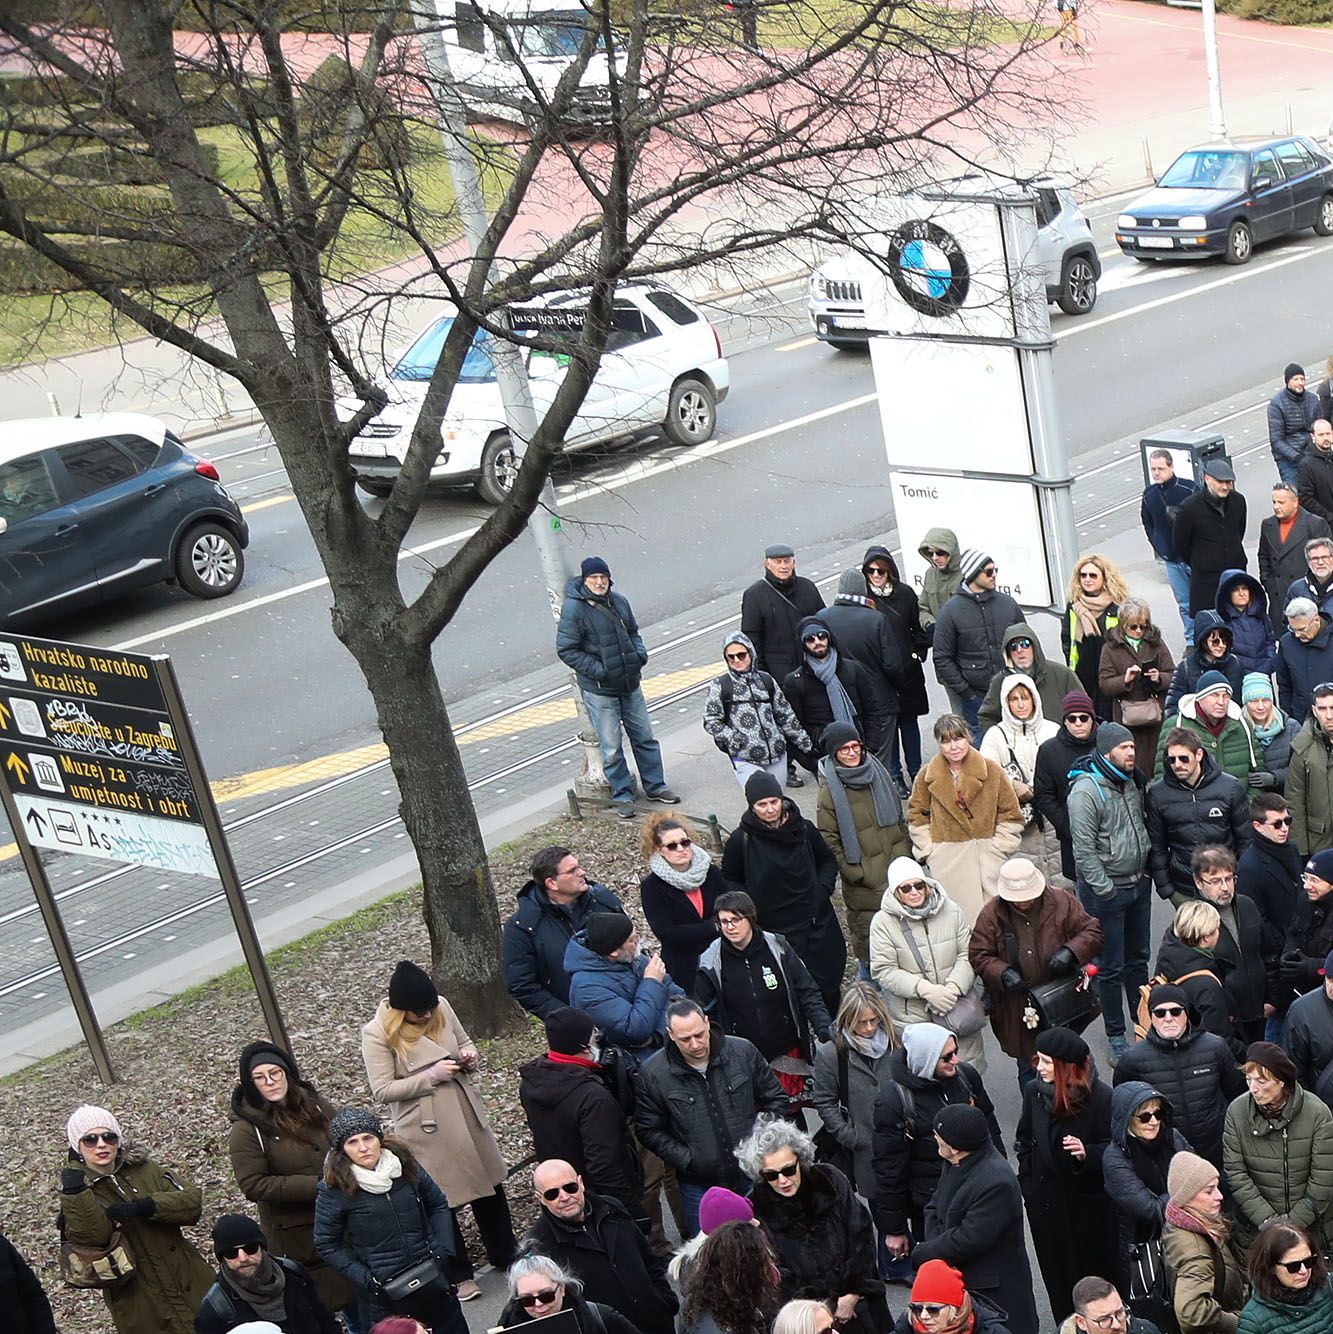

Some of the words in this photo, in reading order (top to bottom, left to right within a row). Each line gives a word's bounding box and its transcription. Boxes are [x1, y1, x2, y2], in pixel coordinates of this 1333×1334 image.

[893, 222, 958, 256] BMW
[900, 484, 938, 499] Tomić
[1014, 582, 1022, 595] 4
[21, 641, 86, 670] Hrvatsko
[89, 657, 149, 680] narodno
[31, 668, 98, 697] kazalište
[114, 728, 125, 743] u
[125, 725, 178, 752] Zagrebu
[60, 754, 105, 784] Muzej
[109, 767, 127, 783] za
[70, 784, 144, 811] umjetnost
[147, 794, 155, 811] i
[159, 799, 191, 819] obrt
